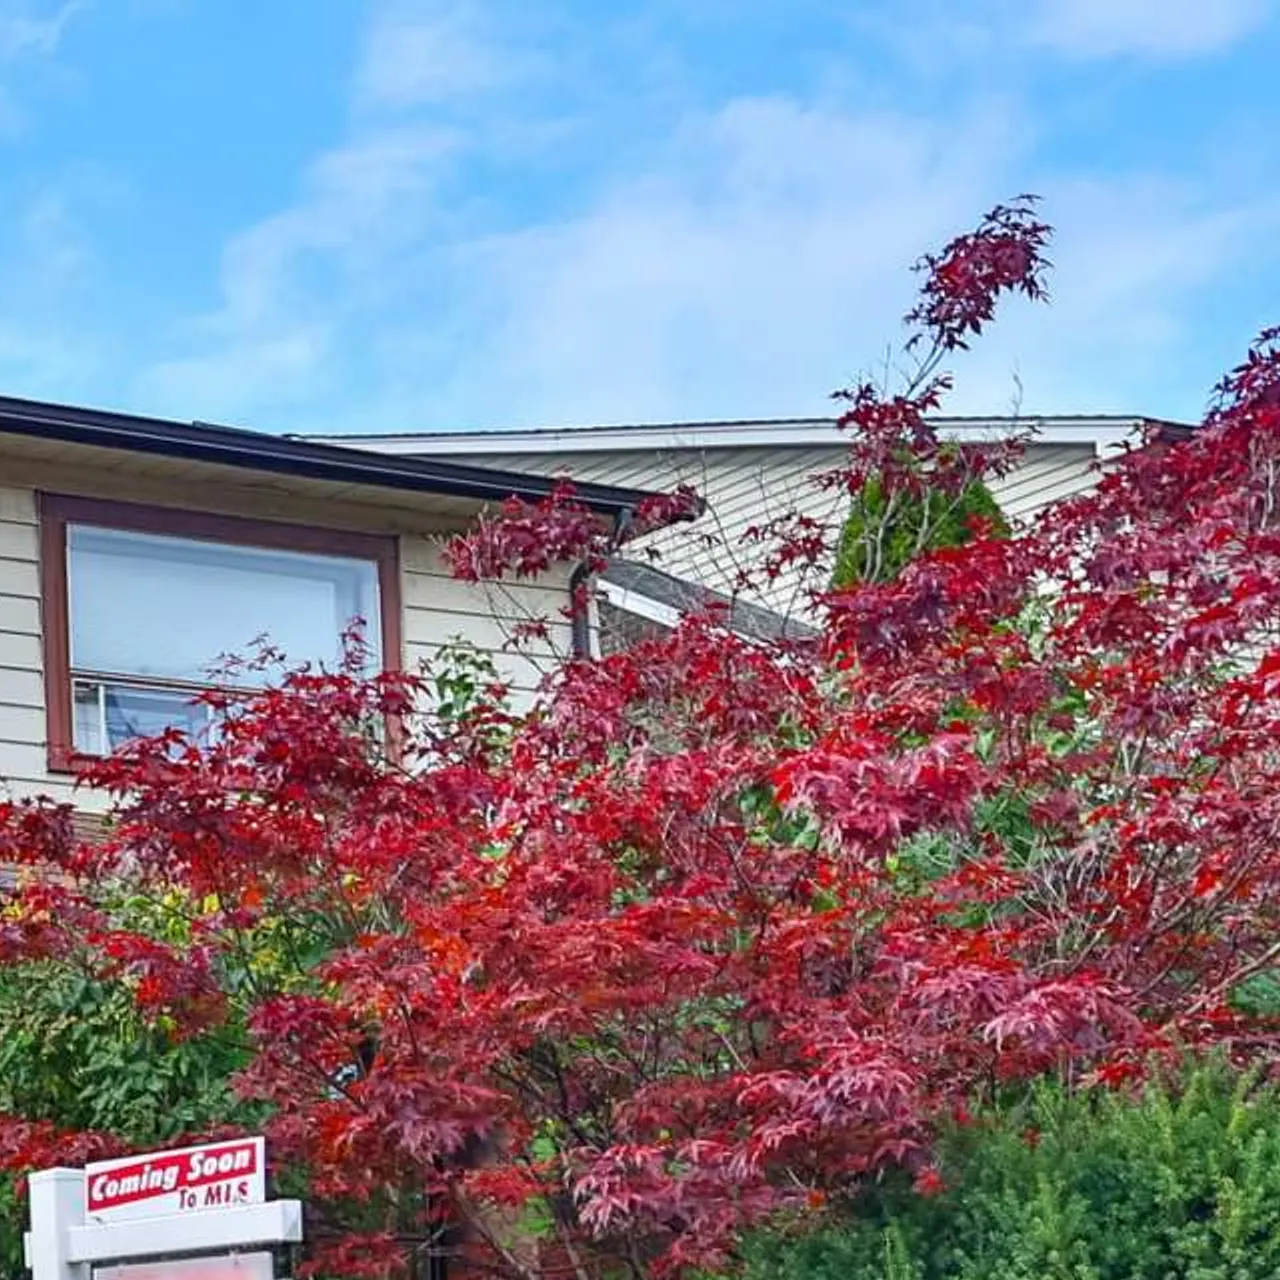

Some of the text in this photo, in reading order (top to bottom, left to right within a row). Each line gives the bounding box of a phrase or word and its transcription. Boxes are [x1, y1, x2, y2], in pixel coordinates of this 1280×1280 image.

[92, 1148, 251, 1201] Coming Soon
[179, 1187, 197, 1209] To
